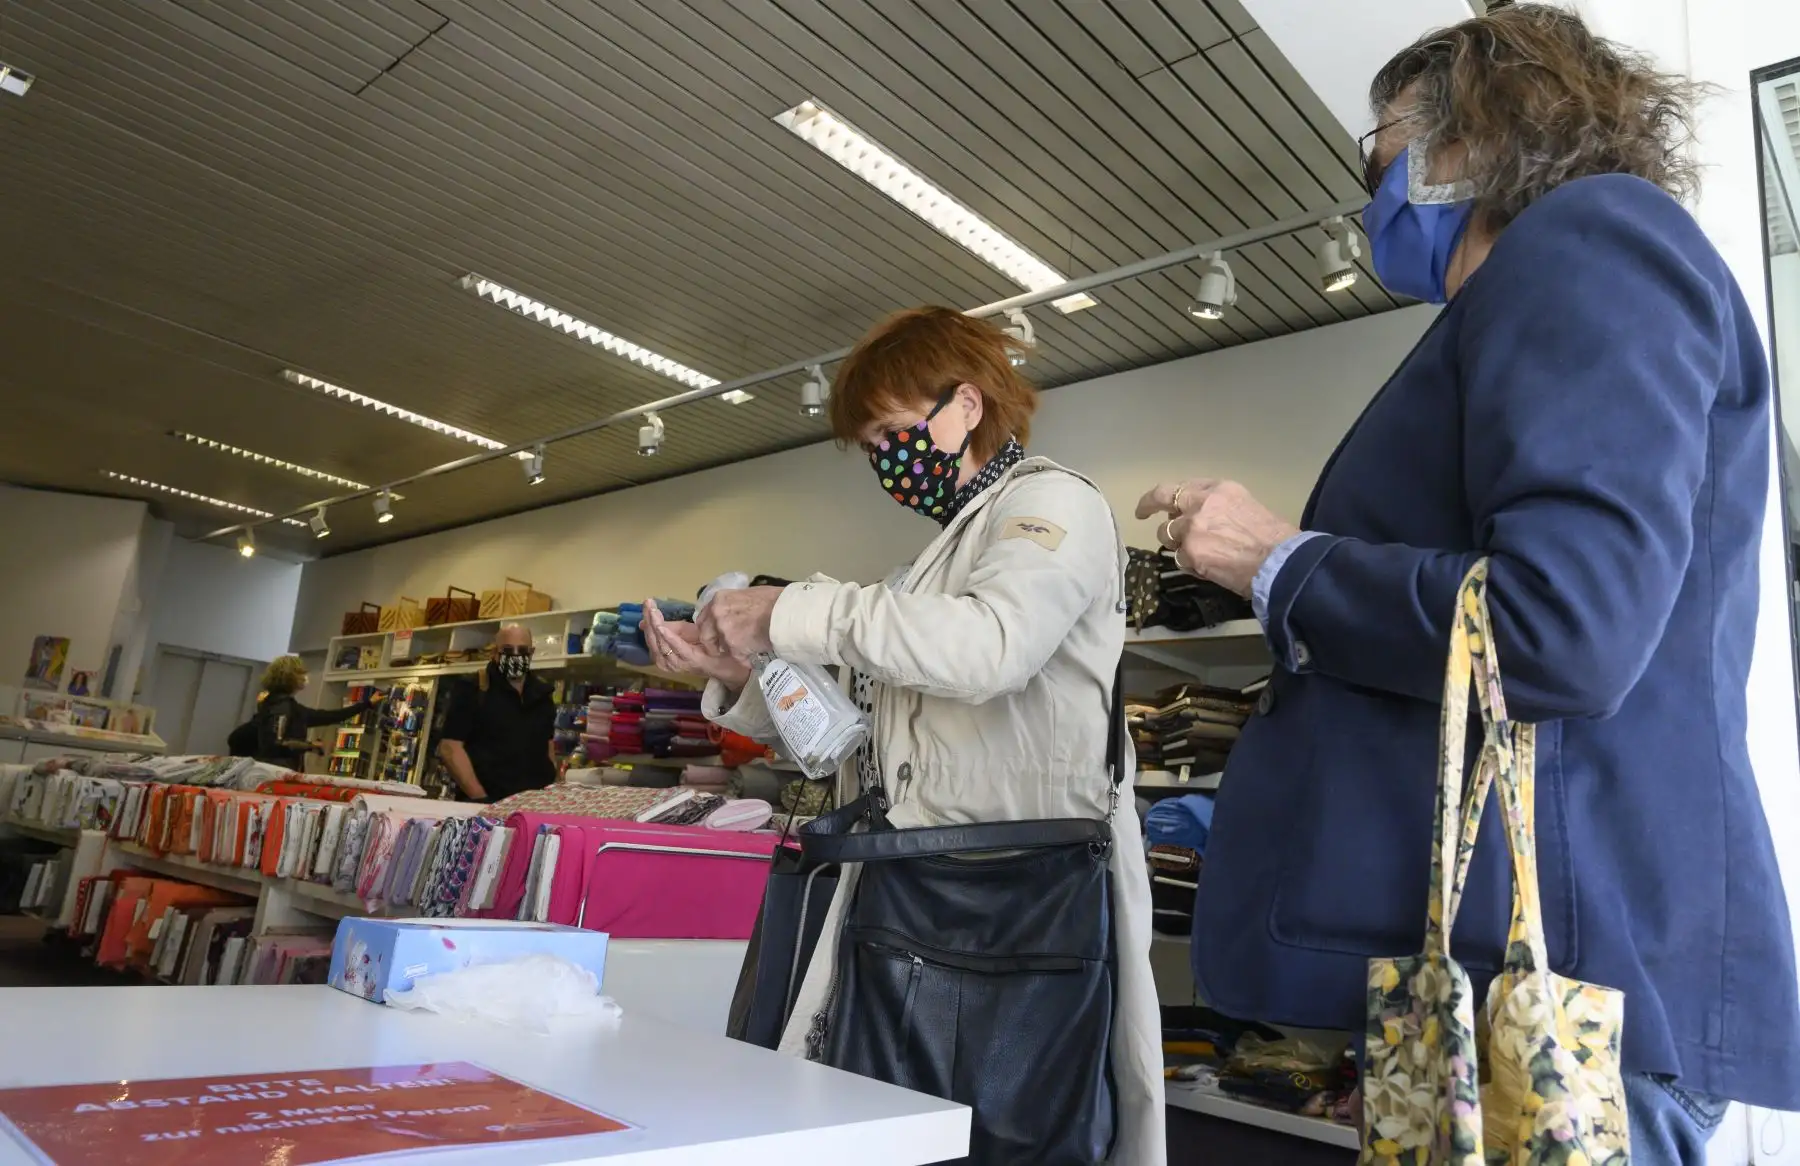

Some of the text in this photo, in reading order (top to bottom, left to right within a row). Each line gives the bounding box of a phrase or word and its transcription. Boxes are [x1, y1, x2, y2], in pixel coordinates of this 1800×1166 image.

[73, 1078, 456, 1113] ABSTAND HALTEN!
[206, 1078, 325, 1092] BITTE
[139, 1103, 491, 1142] zur nächsten Person
[246, 1103, 376, 1120] 2 Meter
